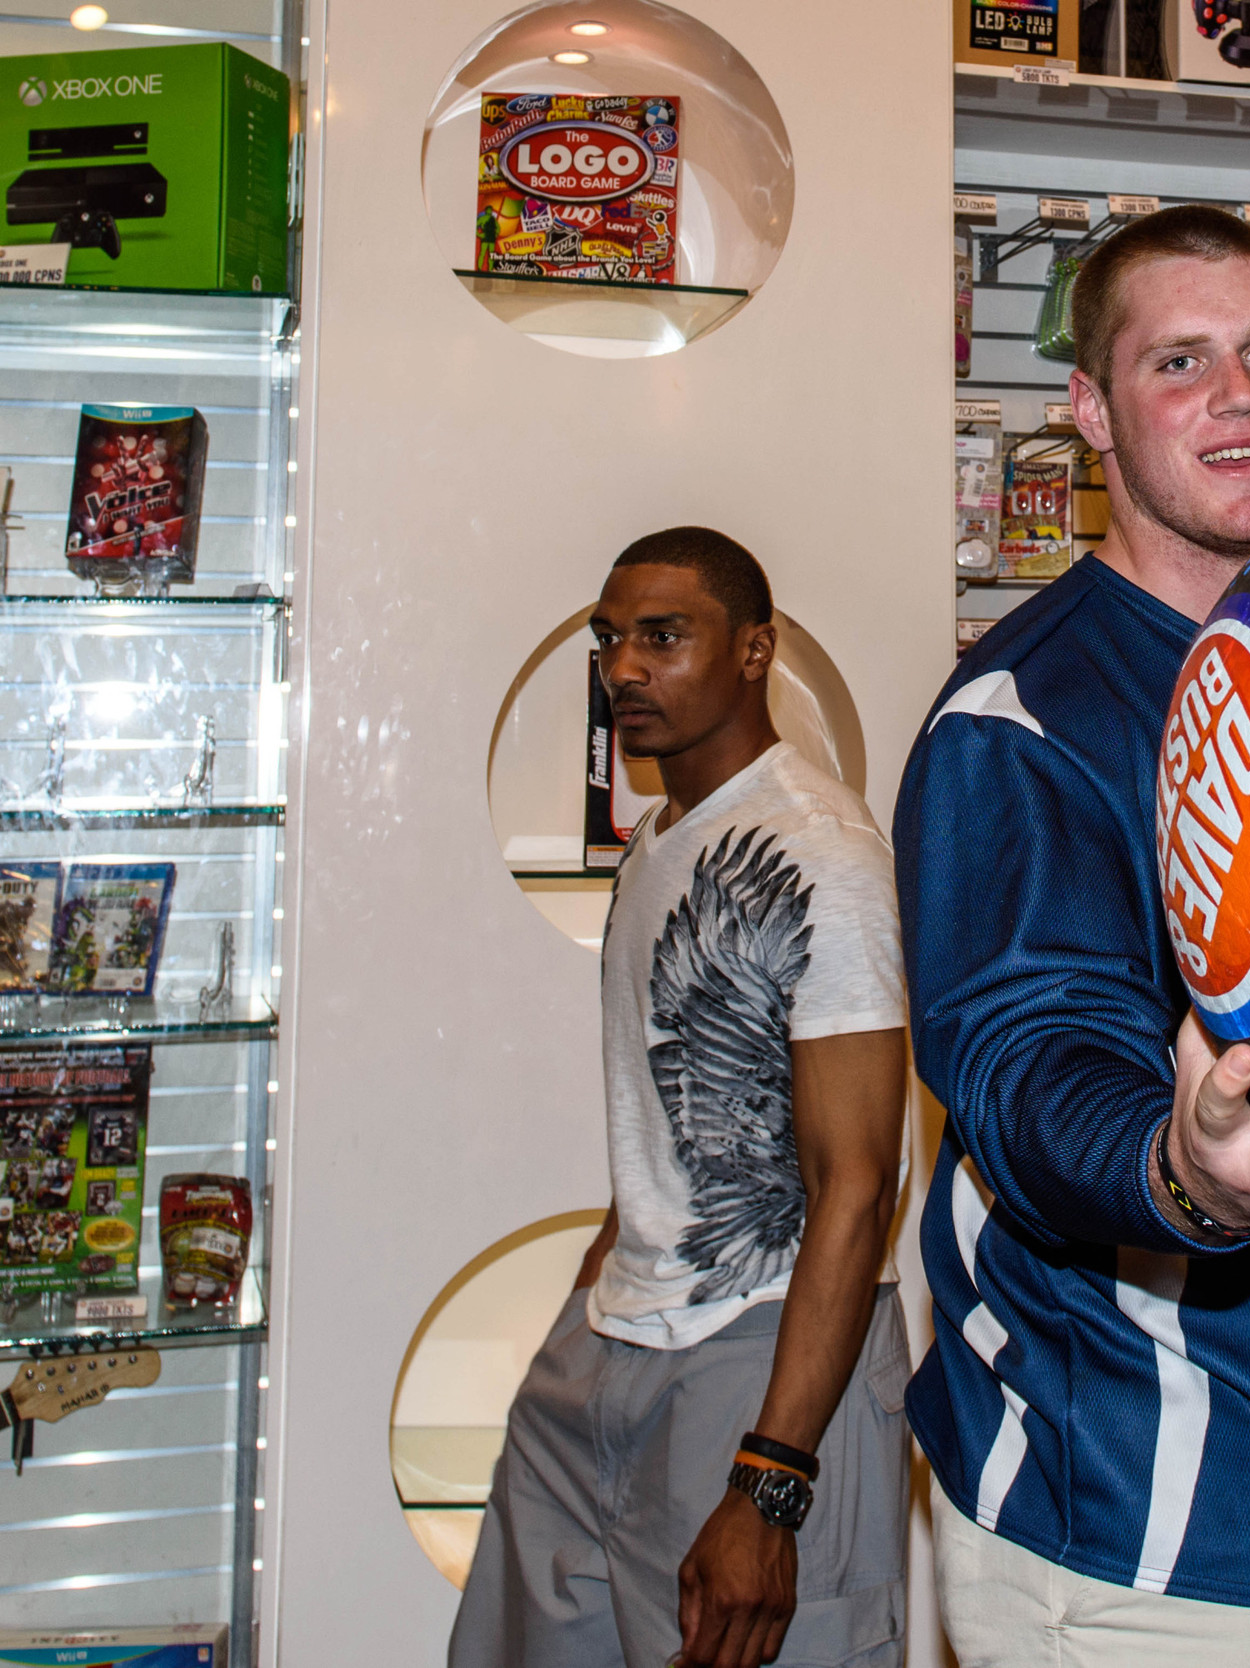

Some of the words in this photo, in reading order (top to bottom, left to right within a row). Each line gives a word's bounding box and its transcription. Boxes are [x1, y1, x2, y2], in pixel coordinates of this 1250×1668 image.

[975, 9, 1005, 30] LED
[1026, 15, 1053, 26] BULB
[1026, 26, 1053, 36] LAMP
[1022, 73, 1039, 82] 5800
[1041, 74, 1060, 84] TKTS
[52, 77, 112, 100] XBOX
[115, 74, 163, 96] ONE
[516, 98, 547, 111] Ford
[551, 96, 585, 111] Lucky
[482, 104, 506, 122] ups
[547, 110, 590, 122] Charms
[565, 130, 590, 143] The
[517, 144, 640, 177] LOGO
[530, 176, 577, 188] BOARD
[580, 177, 620, 190] GAME
[1067, 210, 1086, 219] CPNS
[1137, 204, 1155, 212] TKTS
[525, 217, 550, 226] TACO
[560, 206, 596, 226] DQ
[526, 224, 550, 232] BELL
[503, 236, 543, 251] Denny's
[551, 238, 576, 256] NHL
[529, 253, 552, 261] Game
[34, 269, 62, 282] CPNS
[956, 405, 977, 417] 700
[145, 497, 171, 513] YOU
[999, 541, 1041, 554] Earbuds
[589, 727, 610, 790] Franklin
[3, 881, 38, 894] DUTY
[103, 1128, 122, 1147] 12
